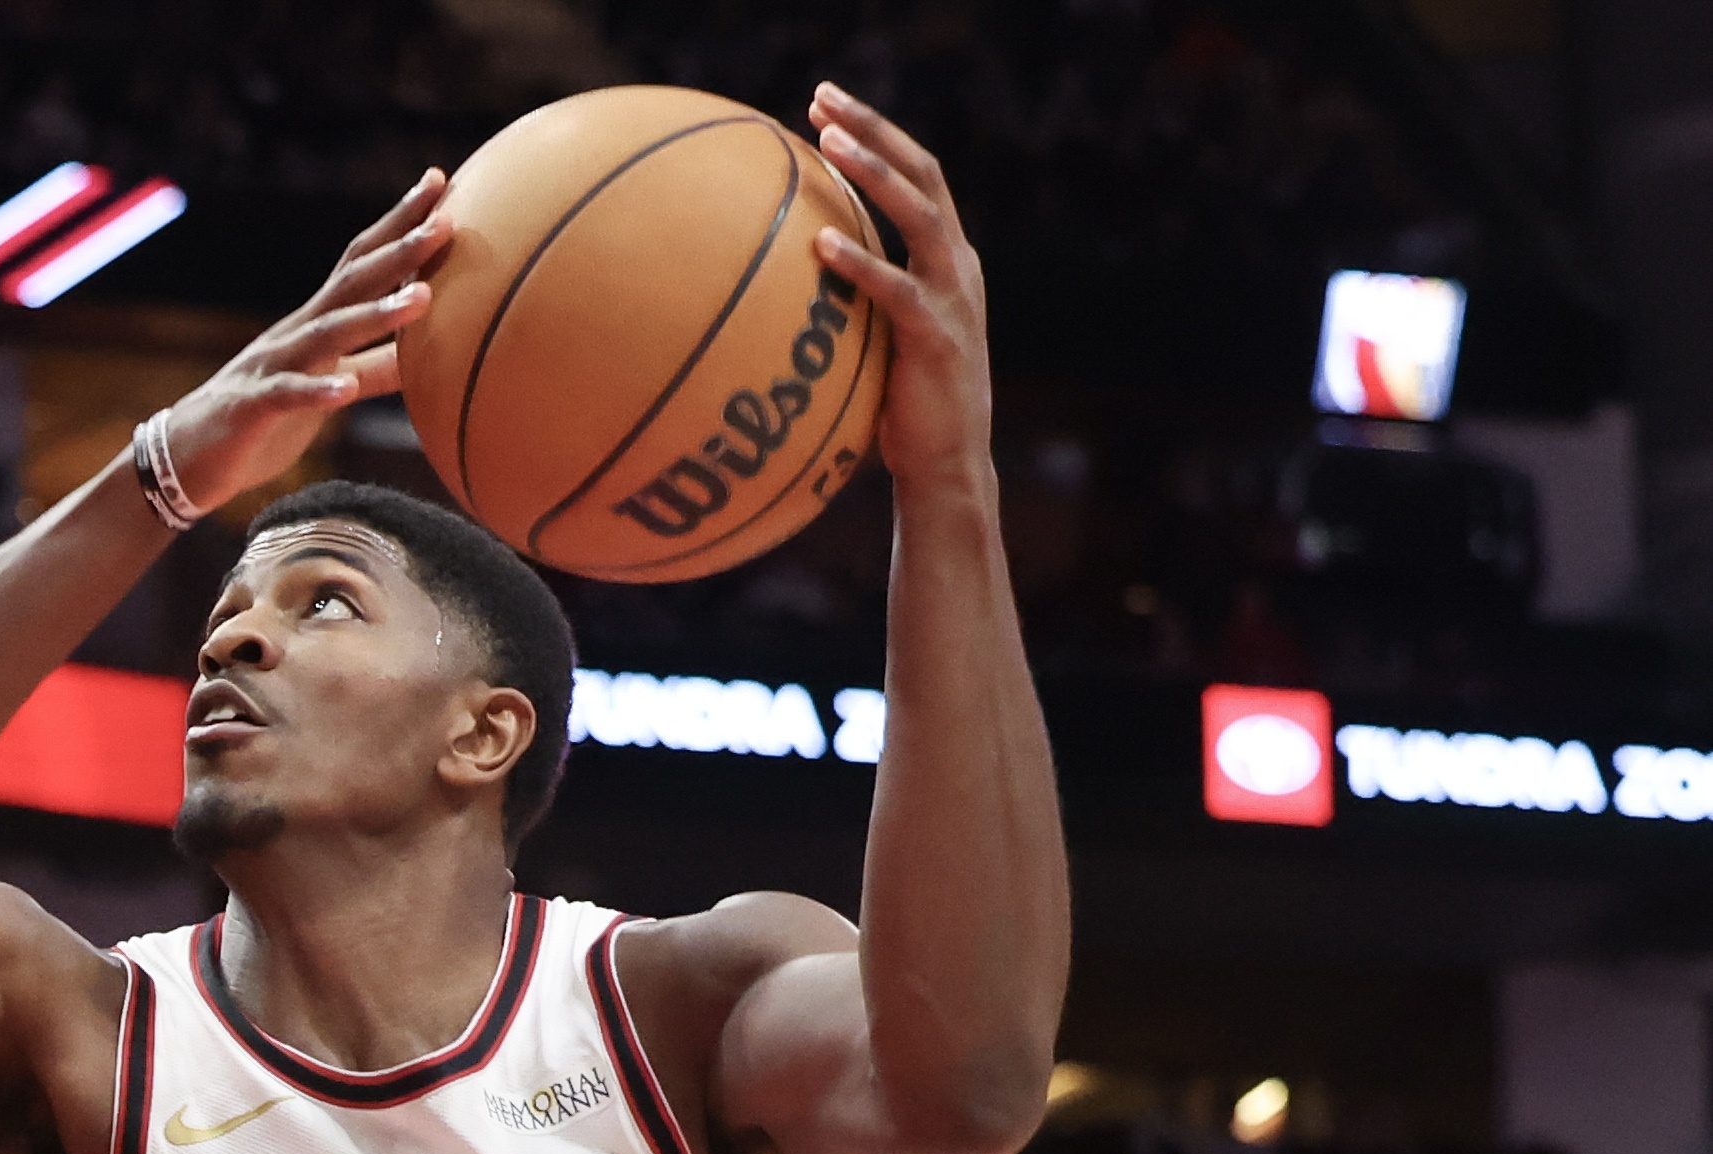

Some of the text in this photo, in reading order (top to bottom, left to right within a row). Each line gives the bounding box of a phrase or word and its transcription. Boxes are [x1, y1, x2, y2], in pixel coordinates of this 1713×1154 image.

[612, 266, 857, 537] Wilson
[1336, 724, 1608, 815] TUNDRA
[484, 1067, 607, 1116] MEMORIAL
[488, 1084, 610, 1130] HERMANN
